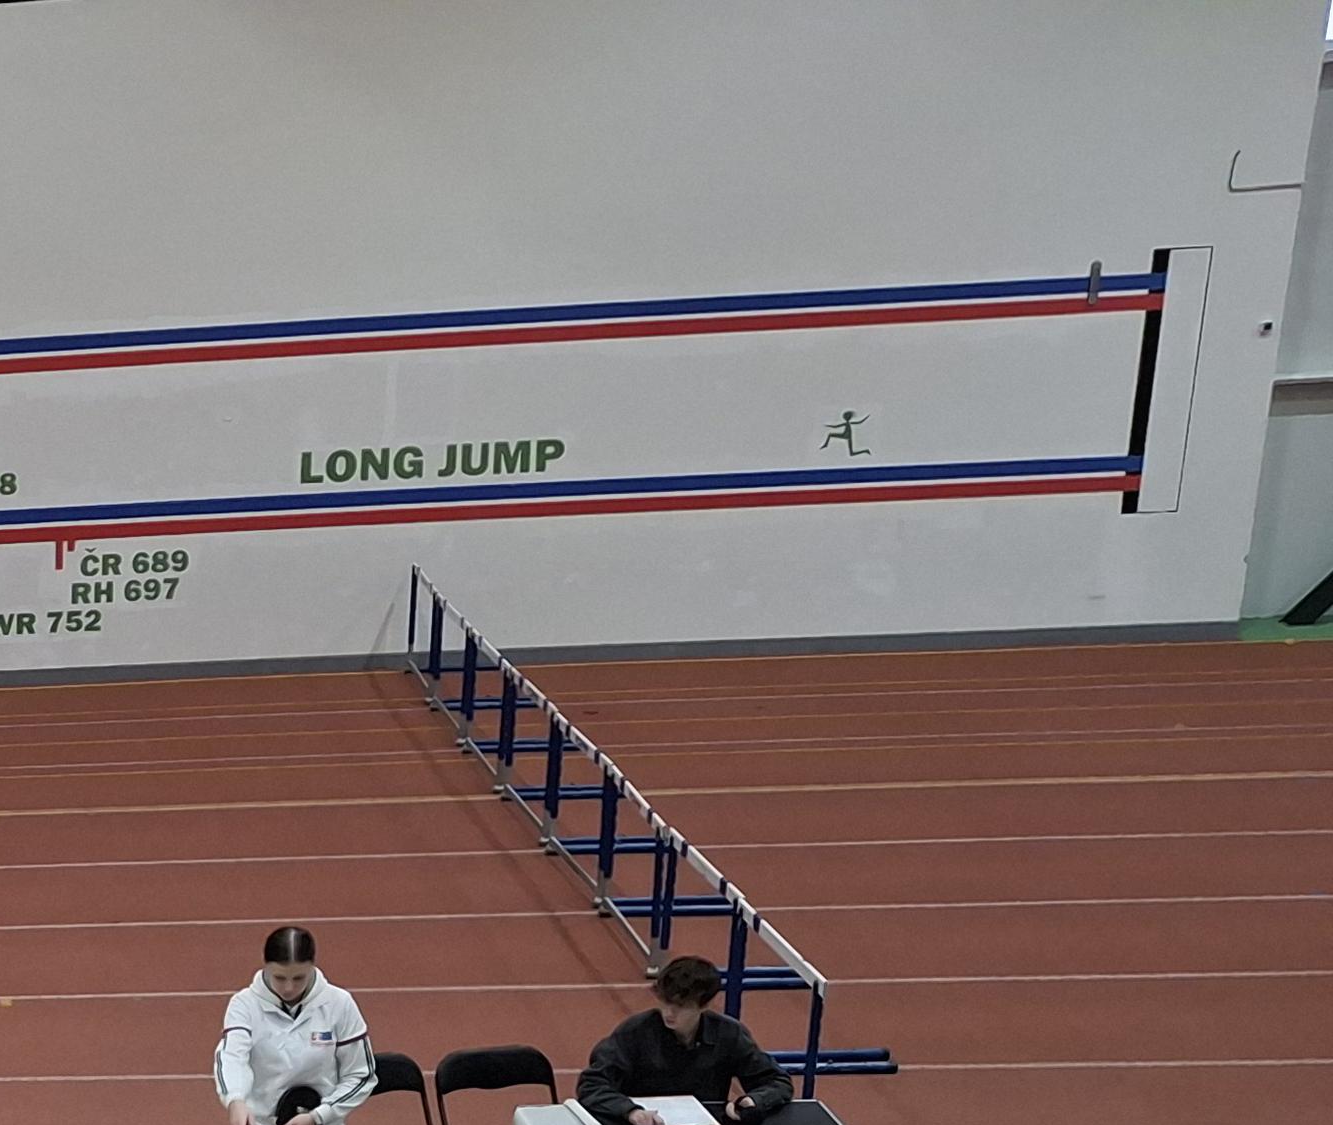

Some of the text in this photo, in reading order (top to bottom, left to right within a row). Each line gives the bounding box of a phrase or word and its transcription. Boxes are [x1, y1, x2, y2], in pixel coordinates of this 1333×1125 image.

[299, 438, 567, 485] LONG JUMP
[79, 547, 190, 577] ČR 689
[70, 577, 181, 605] RH 697
[46, 609, 103, 634] 752
